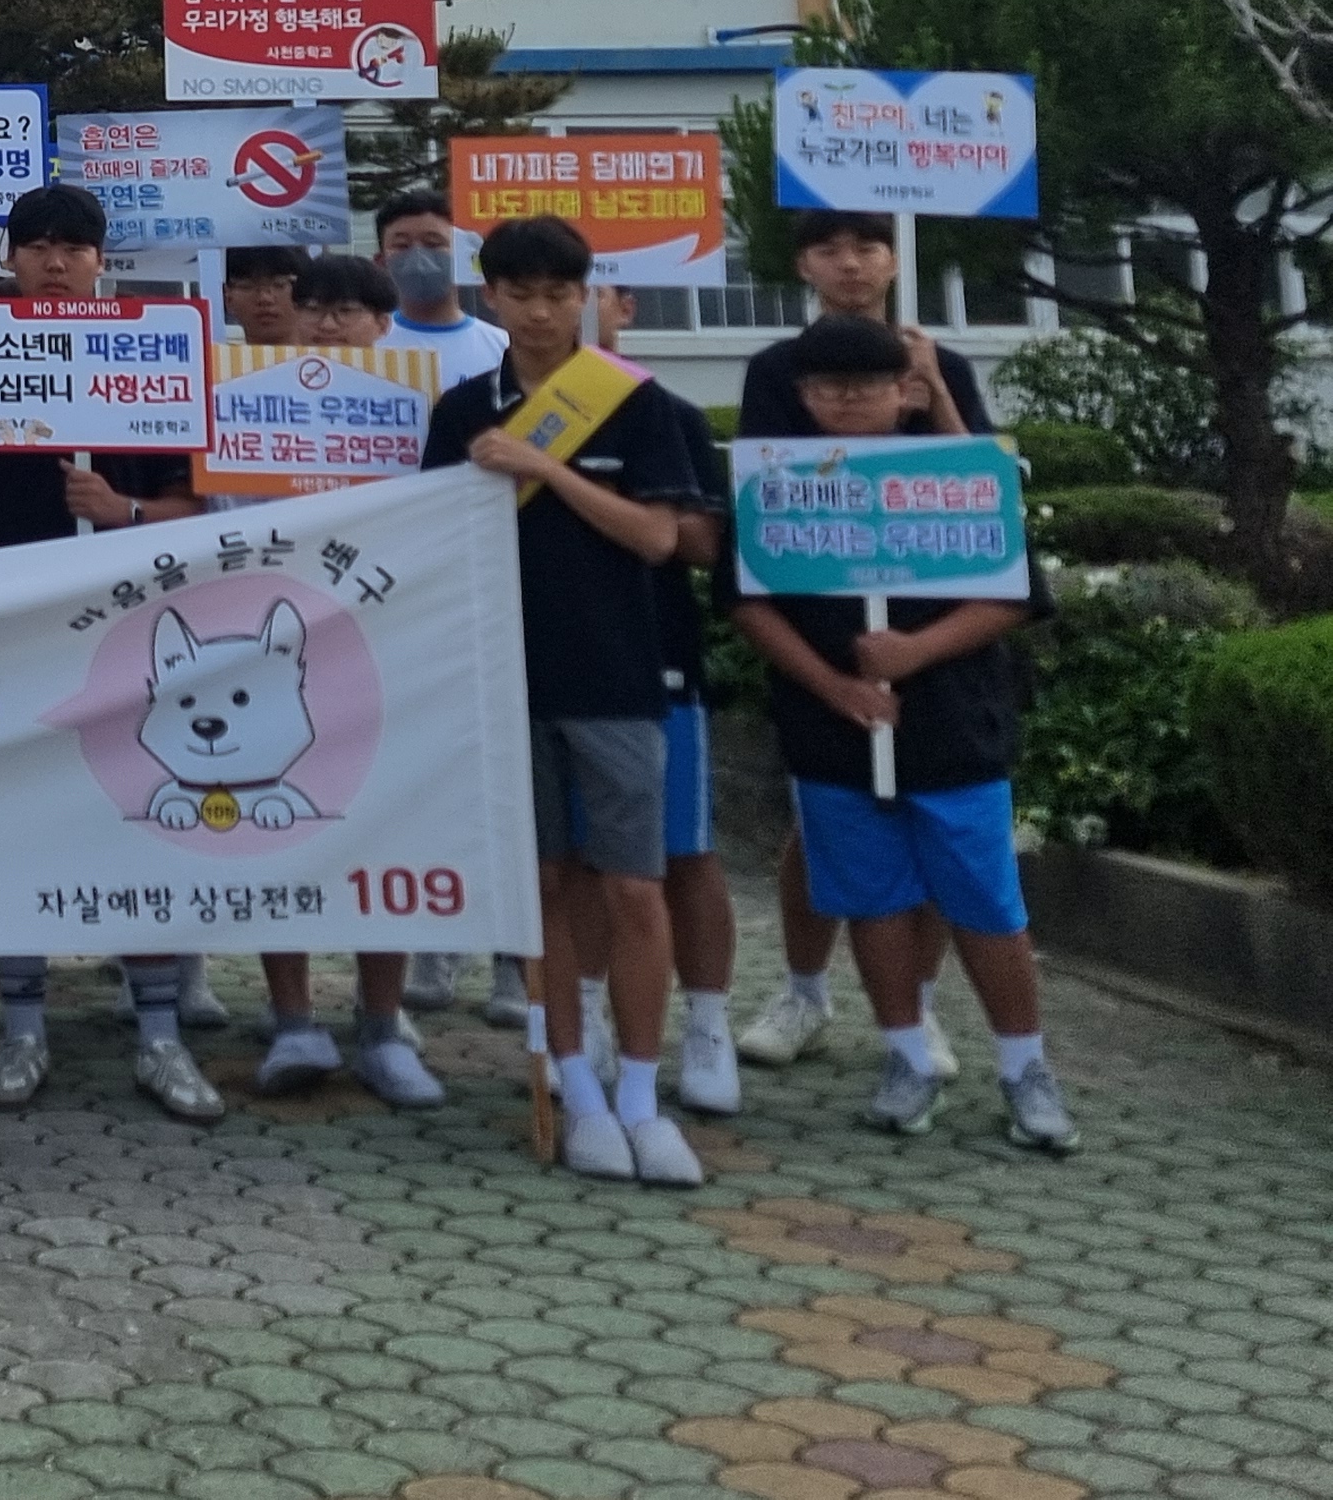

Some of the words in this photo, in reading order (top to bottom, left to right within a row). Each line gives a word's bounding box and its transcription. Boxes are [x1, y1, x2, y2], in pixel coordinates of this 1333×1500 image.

[182, 8, 269, 33] 우리가정
[275, 8, 366, 33] 행복해요
[266, 46, 333, 59] 사천중학교
[182, 79, 215, 95] NO
[223, 77, 324, 95] SMOKING
[924, 106, 973, 135] 너는
[81, 124, 161, 152] 흡연은
[84, 158, 143, 179] 한때의
[149, 156, 210, 178] 즐거움
[590, 151, 705, 182] 담배연기
[797, 139, 899, 169] 누군가의
[907, 140, 1009, 171] 행복이야
[153, 216, 214, 239] 즐거움
[33, 302, 53, 317] NO
[57, 301, 121, 317] SMOKING
[85, 331, 191, 363] 피운담배
[88, 373, 193, 405] 사형선고
[320, 394, 418, 427] 우정보다
[129, 420, 191, 436] 사천중학교
[218, 431, 264, 463] 서로
[324, 433, 421, 466] 금연우정
[69, 551, 190, 634] 마음을
[217, 528, 296, 573] 듣는
[319, 537, 397, 605] 백구
[36, 886, 175, 924] 자살예방
[189, 885, 327, 924] 상담전화
[347, 866, 467, 917] 109
